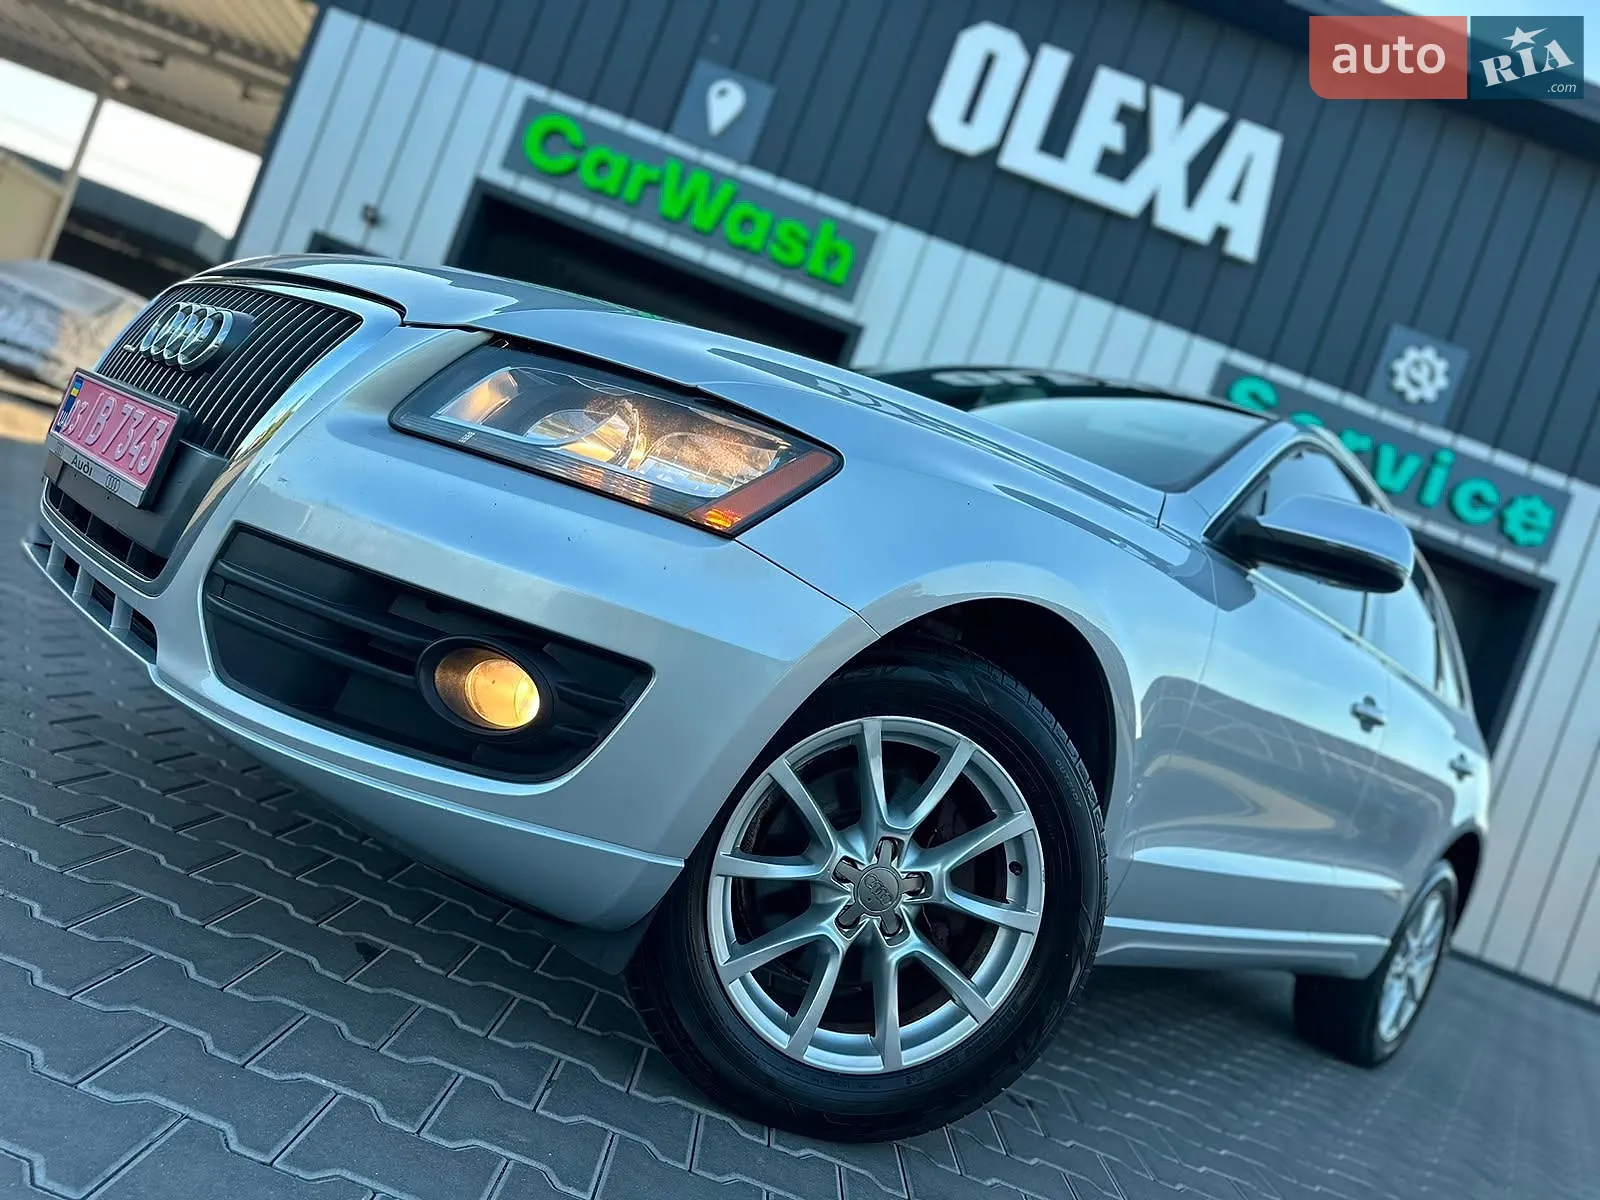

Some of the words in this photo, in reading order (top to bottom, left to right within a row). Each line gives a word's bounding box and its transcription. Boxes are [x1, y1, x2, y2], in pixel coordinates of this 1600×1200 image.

[522, 113, 855, 286] CarWash
[926, 20, 1283, 264] OLEXA
[70, 454, 94, 477] Audi
